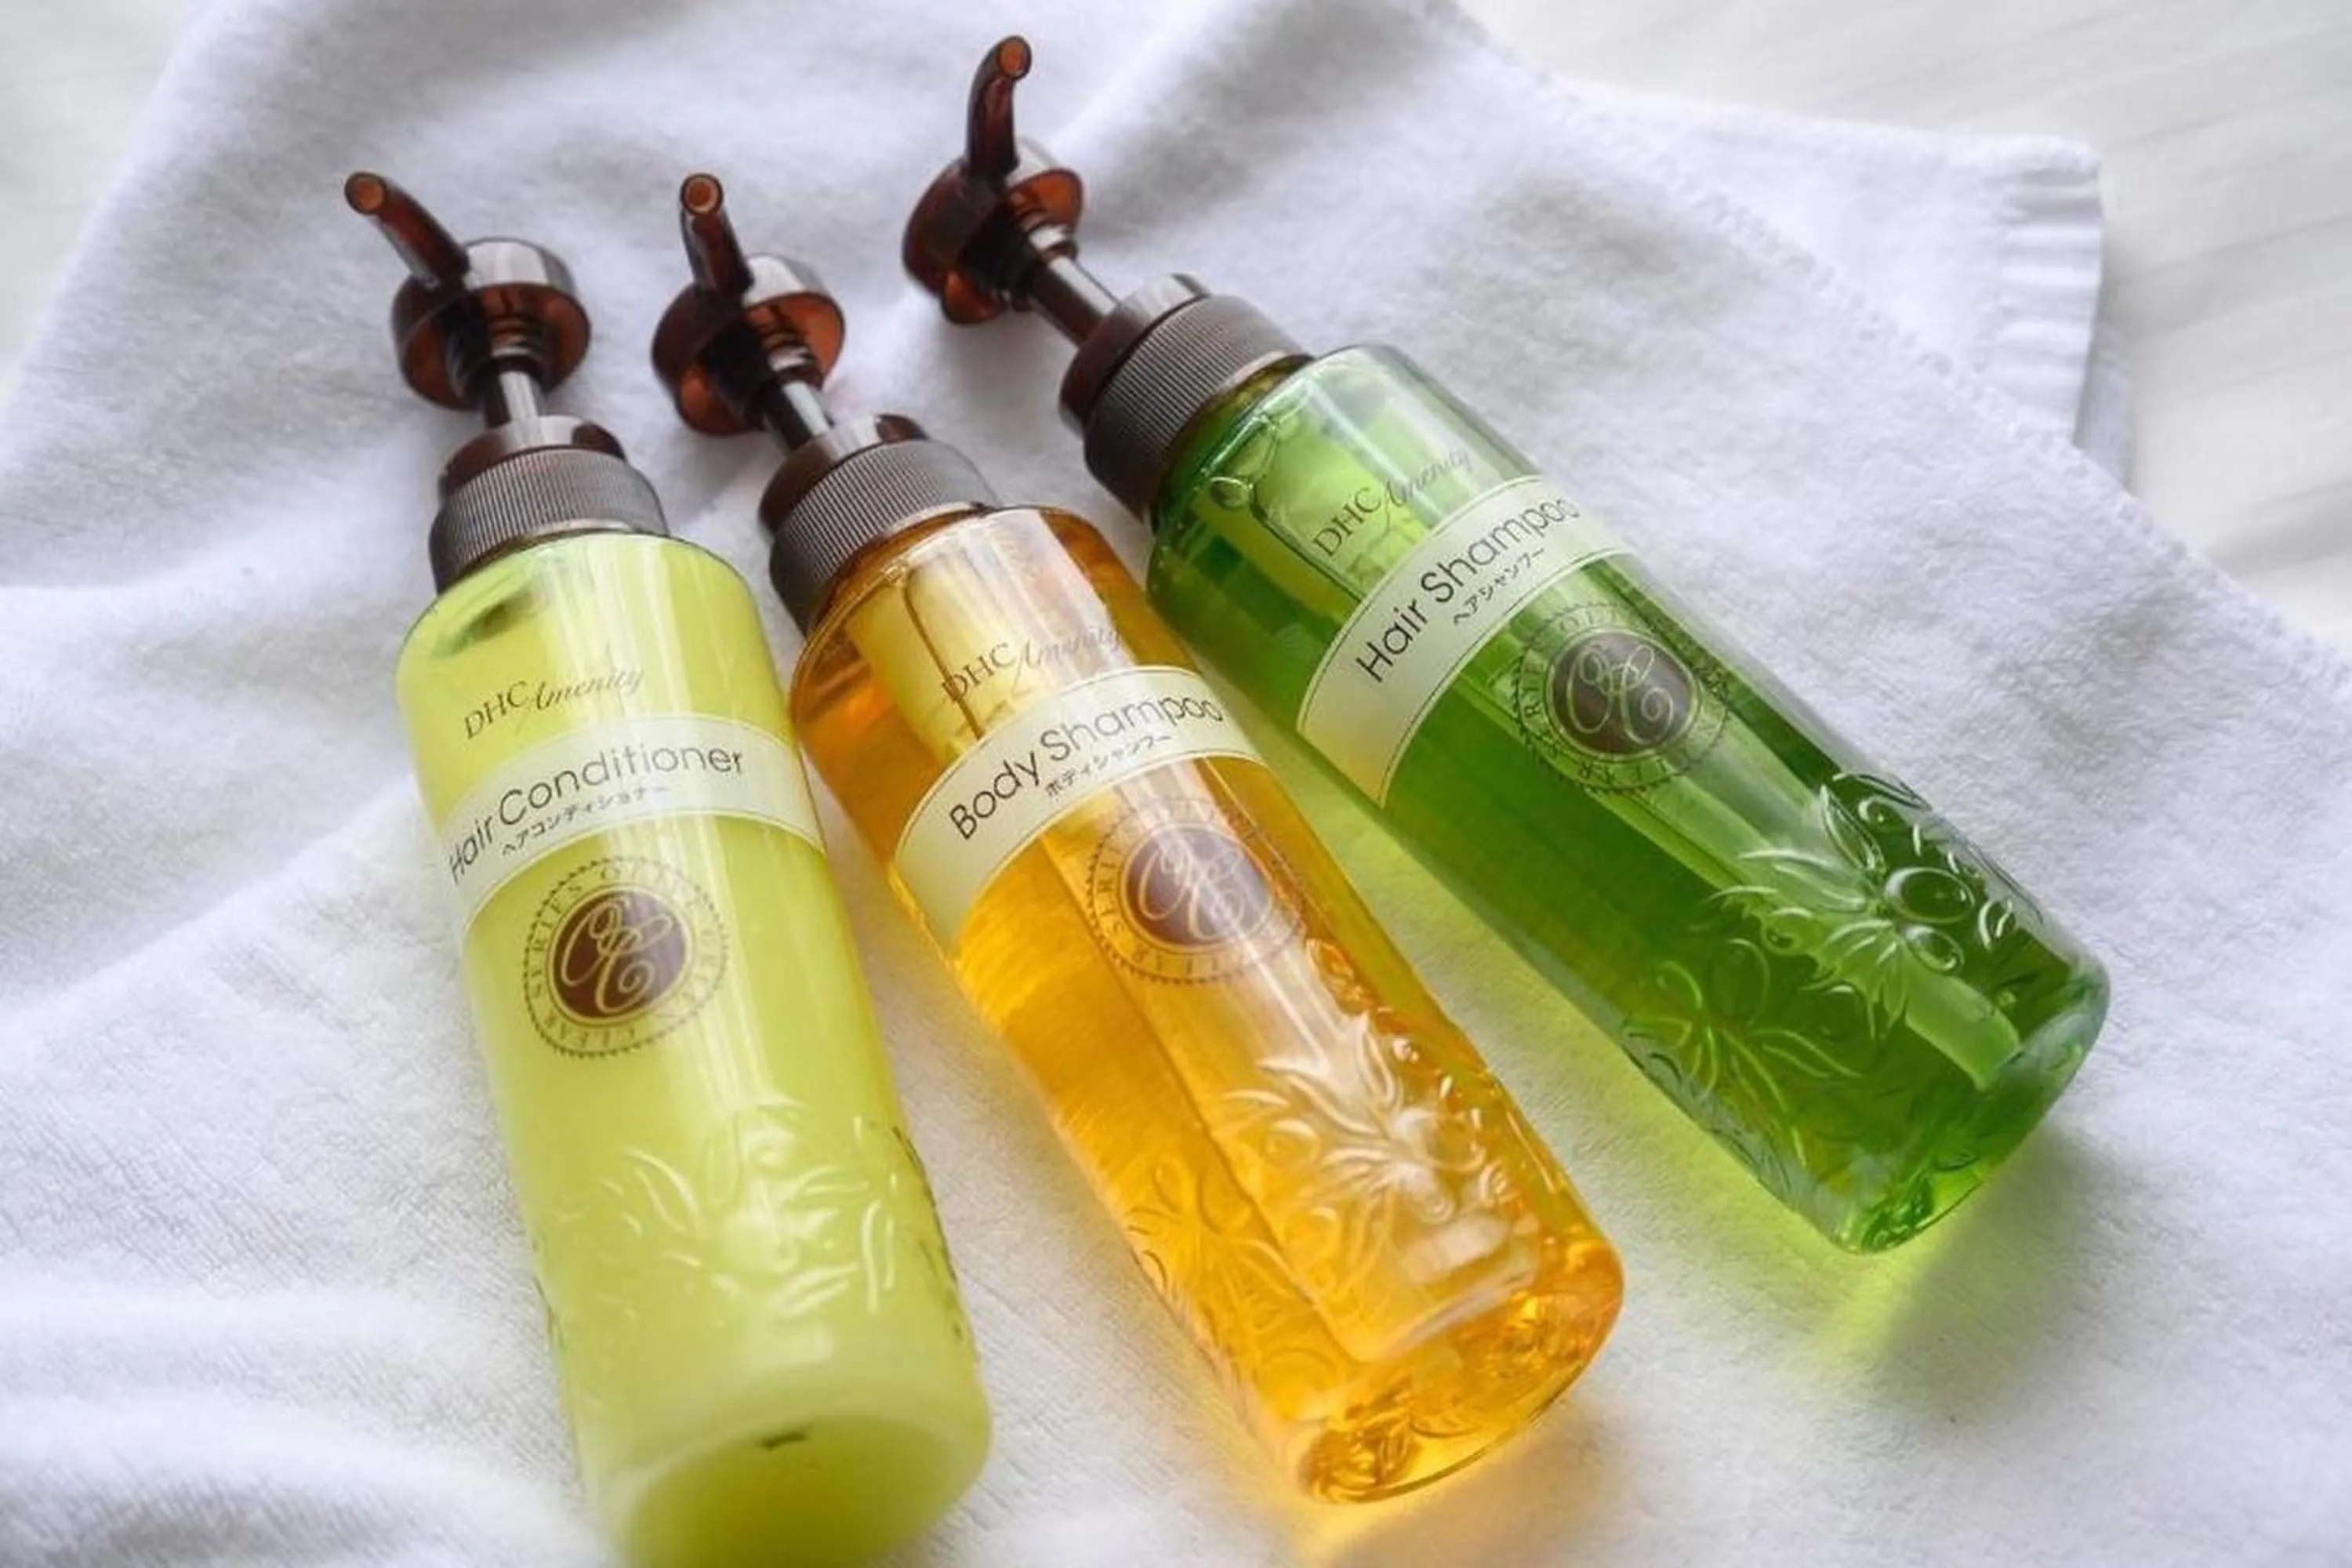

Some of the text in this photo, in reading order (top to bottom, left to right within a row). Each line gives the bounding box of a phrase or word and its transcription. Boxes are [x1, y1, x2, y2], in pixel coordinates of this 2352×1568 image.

[1312, 486, 1382, 557] DHC
[1355, 499, 1581, 684] Hair Shampoo
[464, 680, 528, 740] DHC
[941, 641, 1018, 704] DHC
[449, 744, 745, 886] Hair Conditioner
[949, 695, 1224, 840] Body Shampoo
